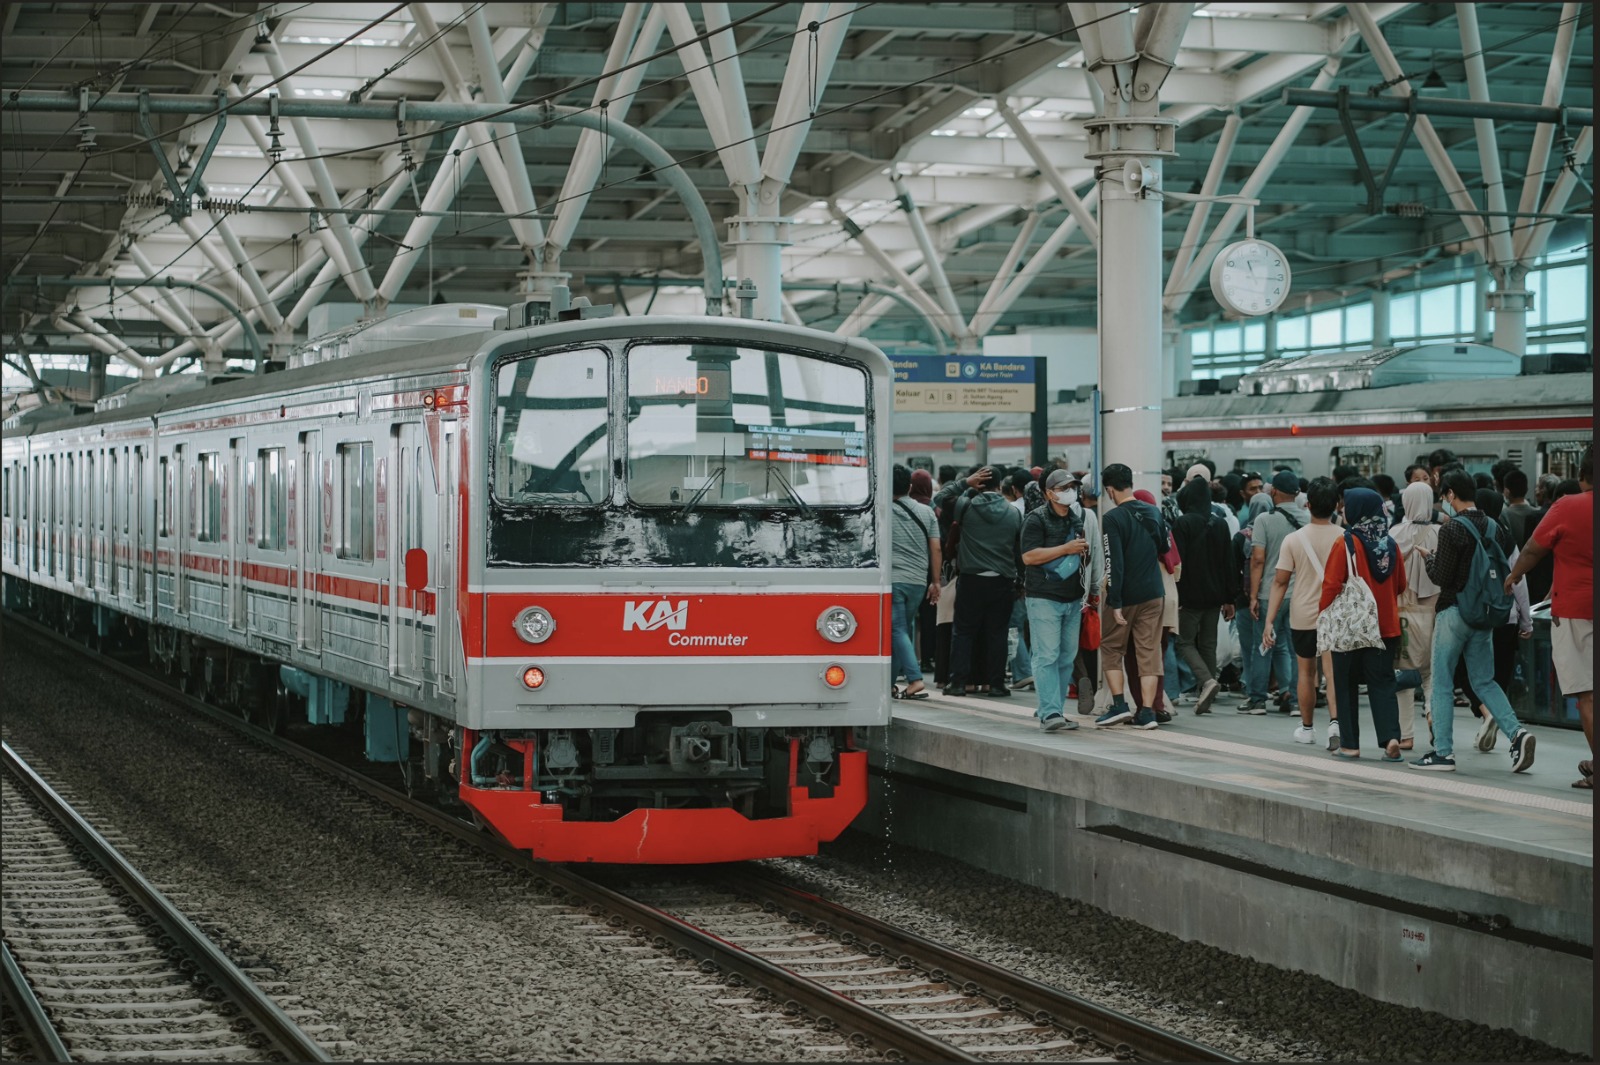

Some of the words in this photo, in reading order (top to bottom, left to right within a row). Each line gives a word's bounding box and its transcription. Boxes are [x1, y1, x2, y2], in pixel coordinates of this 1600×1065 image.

[1274, 259, 1281, 267] 2
[1273, 287, 1280, 295] 4
[1265, 298, 1272, 307] 5
[980, 362, 992, 371] KA
[993, 362, 1026, 371] Bandara
[655, 376, 709, 395] NAMBO
[1103, 533, 1111, 556] KURT
[622, 600, 689, 631] KAI
[668, 632, 749, 647] Commuter
